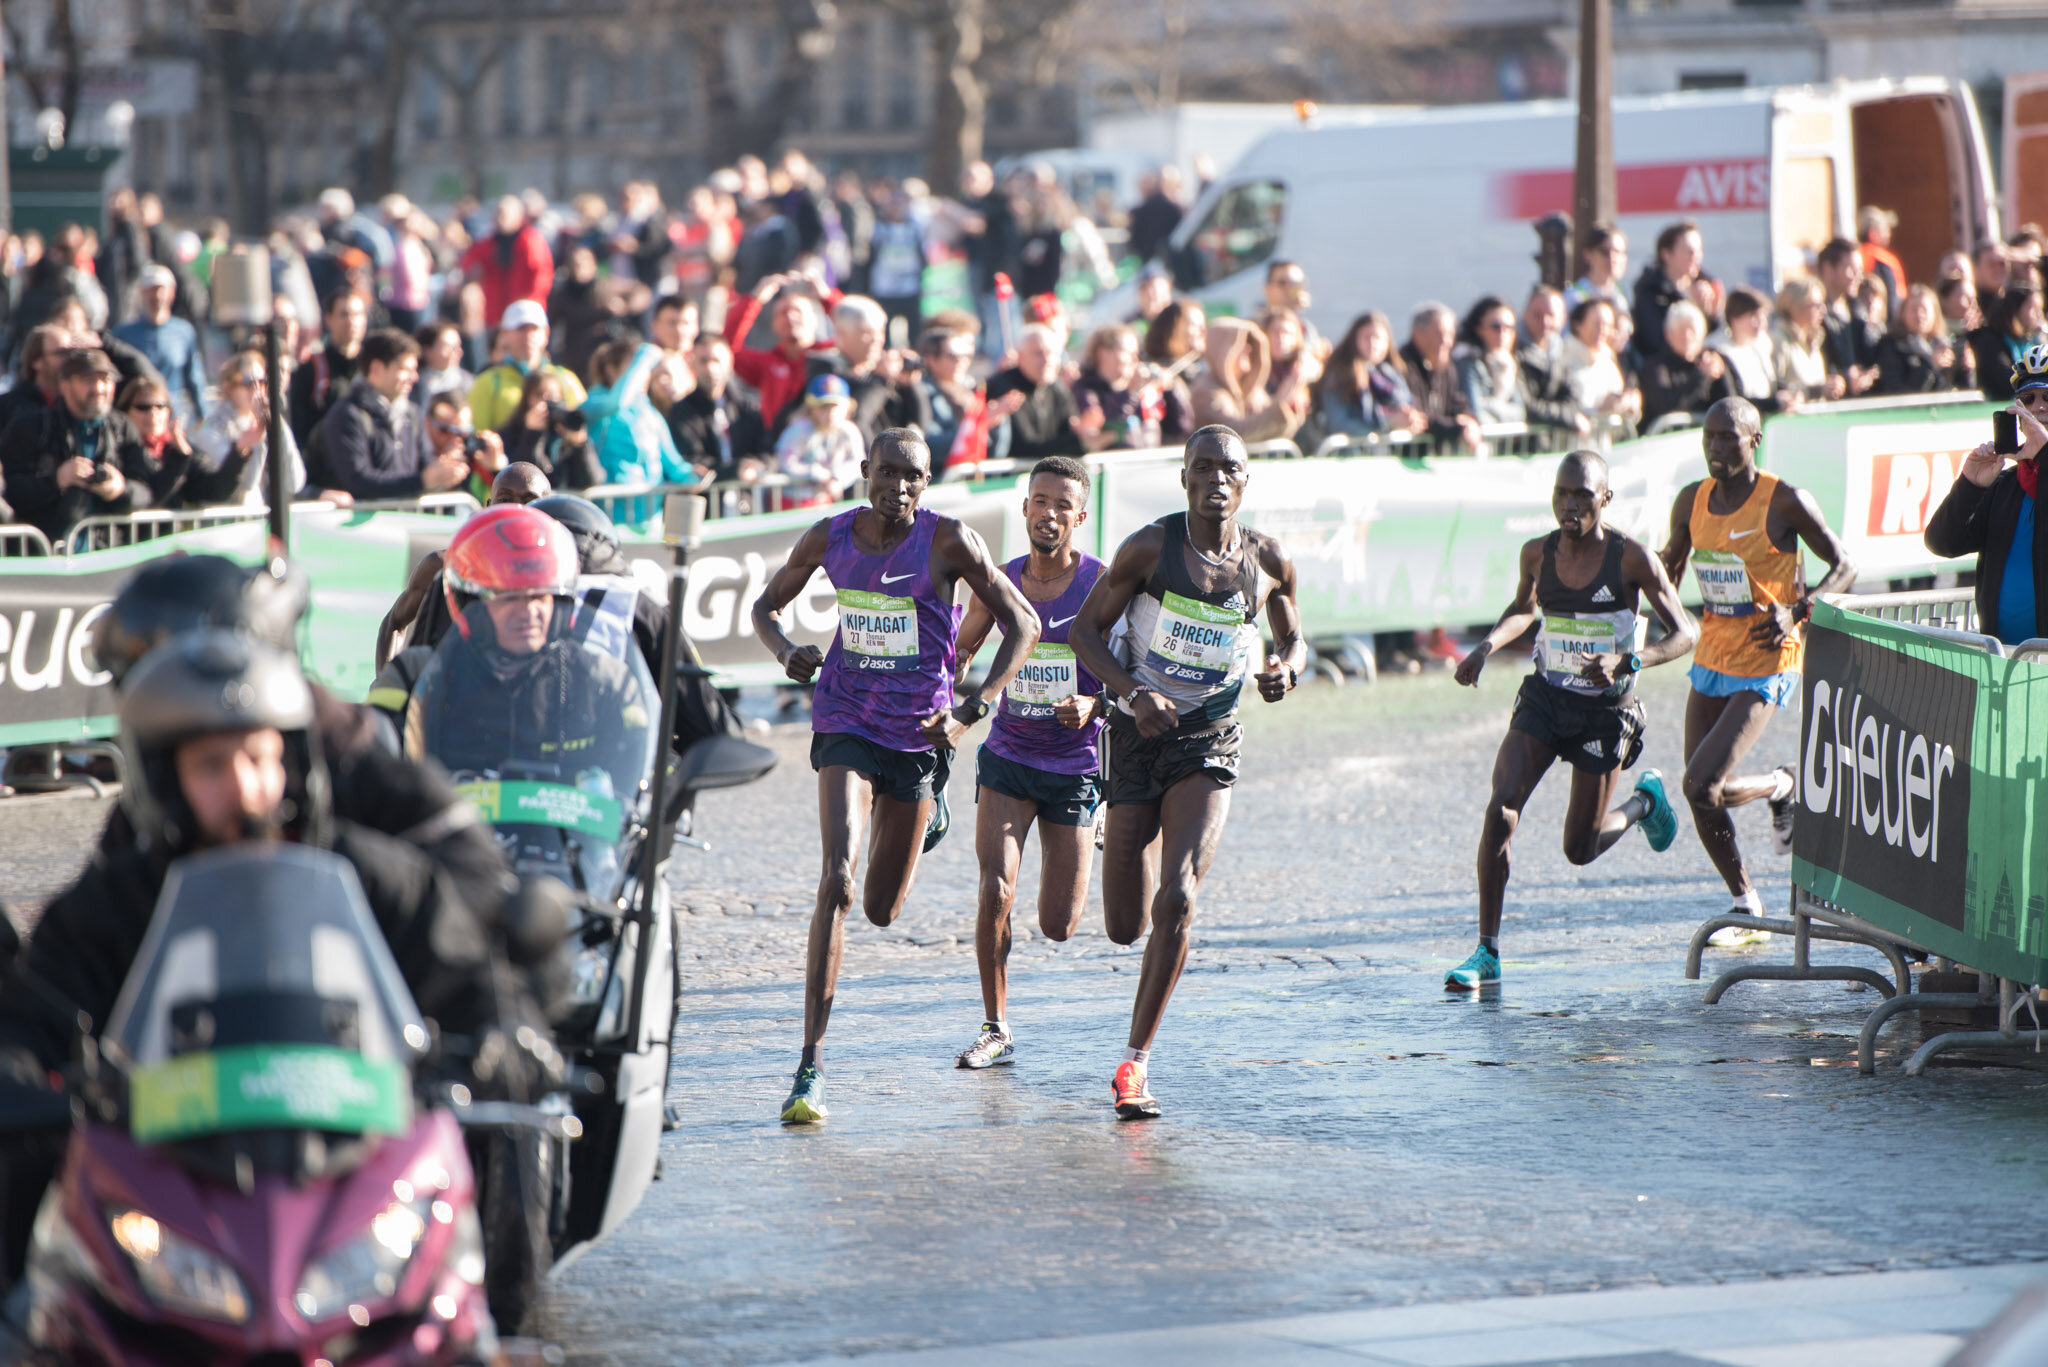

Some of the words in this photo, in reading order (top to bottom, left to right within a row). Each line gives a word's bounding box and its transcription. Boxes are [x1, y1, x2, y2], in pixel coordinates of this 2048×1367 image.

[1676, 164, 1769, 206] AVIS
[846, 613, 907, 633] KIPLAGAT
[850, 632, 860, 644] 27
[1171, 621, 1223, 648] BIRECH
[1163, 636, 1178, 651] 26
[1563, 639, 1596, 655] LAGAT
[869, 659, 896, 669] asics
[1177, 668, 1206, 680] asics
[1014, 680, 1023, 693] 20
[1031, 707, 1056, 716] asics
